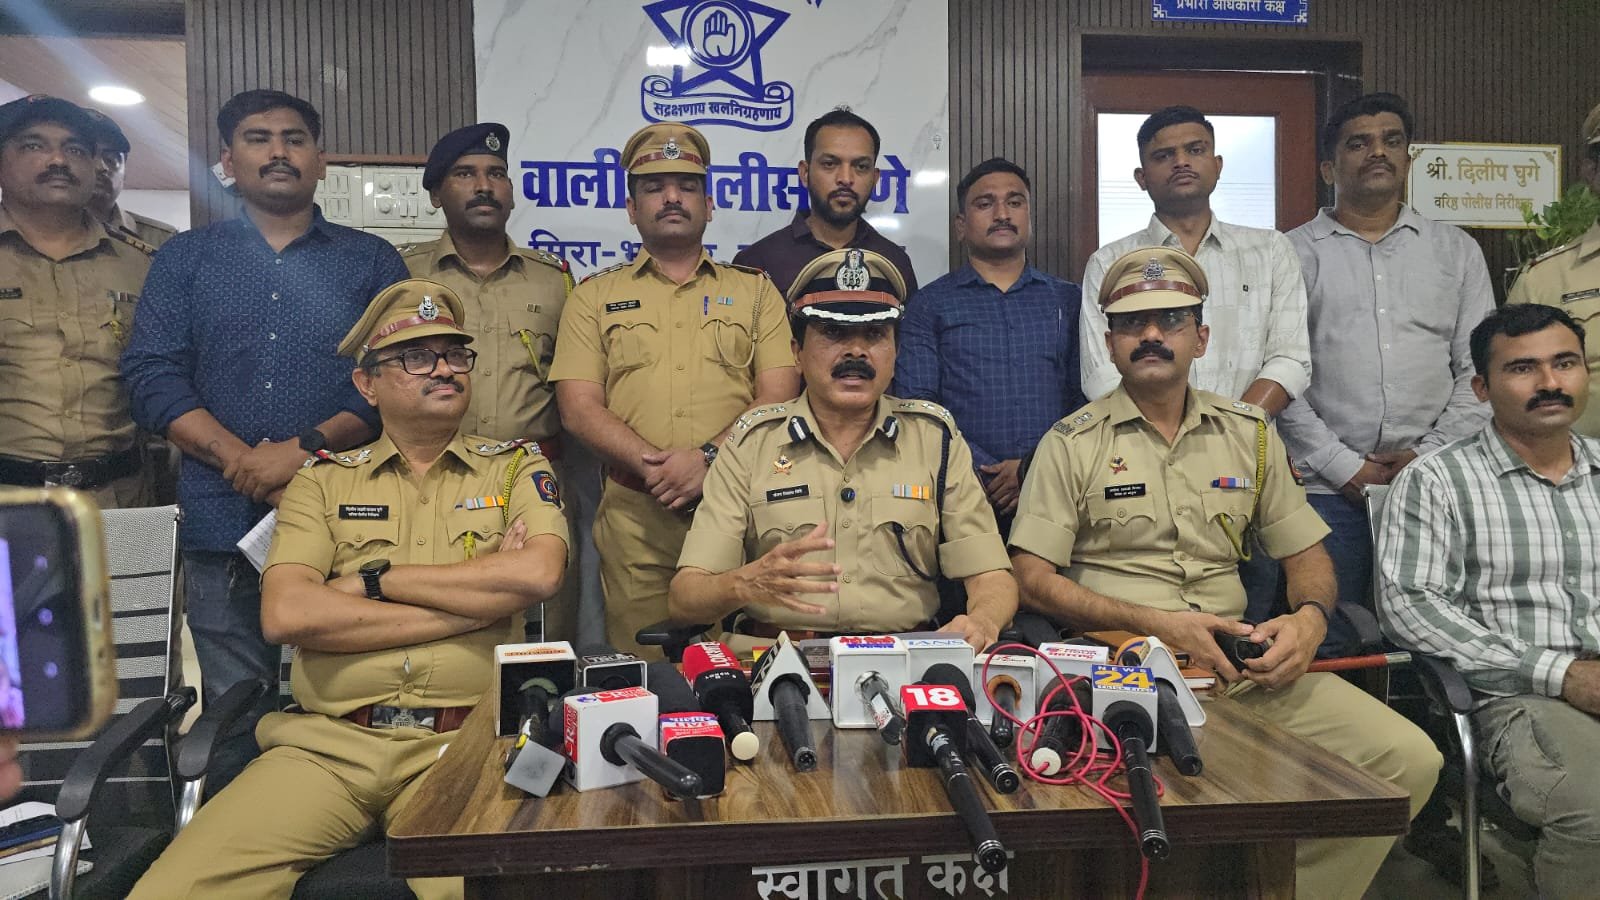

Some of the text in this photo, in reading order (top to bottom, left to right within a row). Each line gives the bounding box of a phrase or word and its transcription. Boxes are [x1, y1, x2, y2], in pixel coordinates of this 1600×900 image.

[521, 148, 627, 210] वाली
[1426, 156, 1540, 187] श्री. दिलीप घुगे
[1462, 192, 1492, 210] पोलीस
[908, 639, 963, 648] IANS
[1097, 665, 1147, 674] NEWS
[1094, 670, 1154, 689] 24
[906, 687, 960, 707] 18
[752, 857, 910, 900] स्वागत
